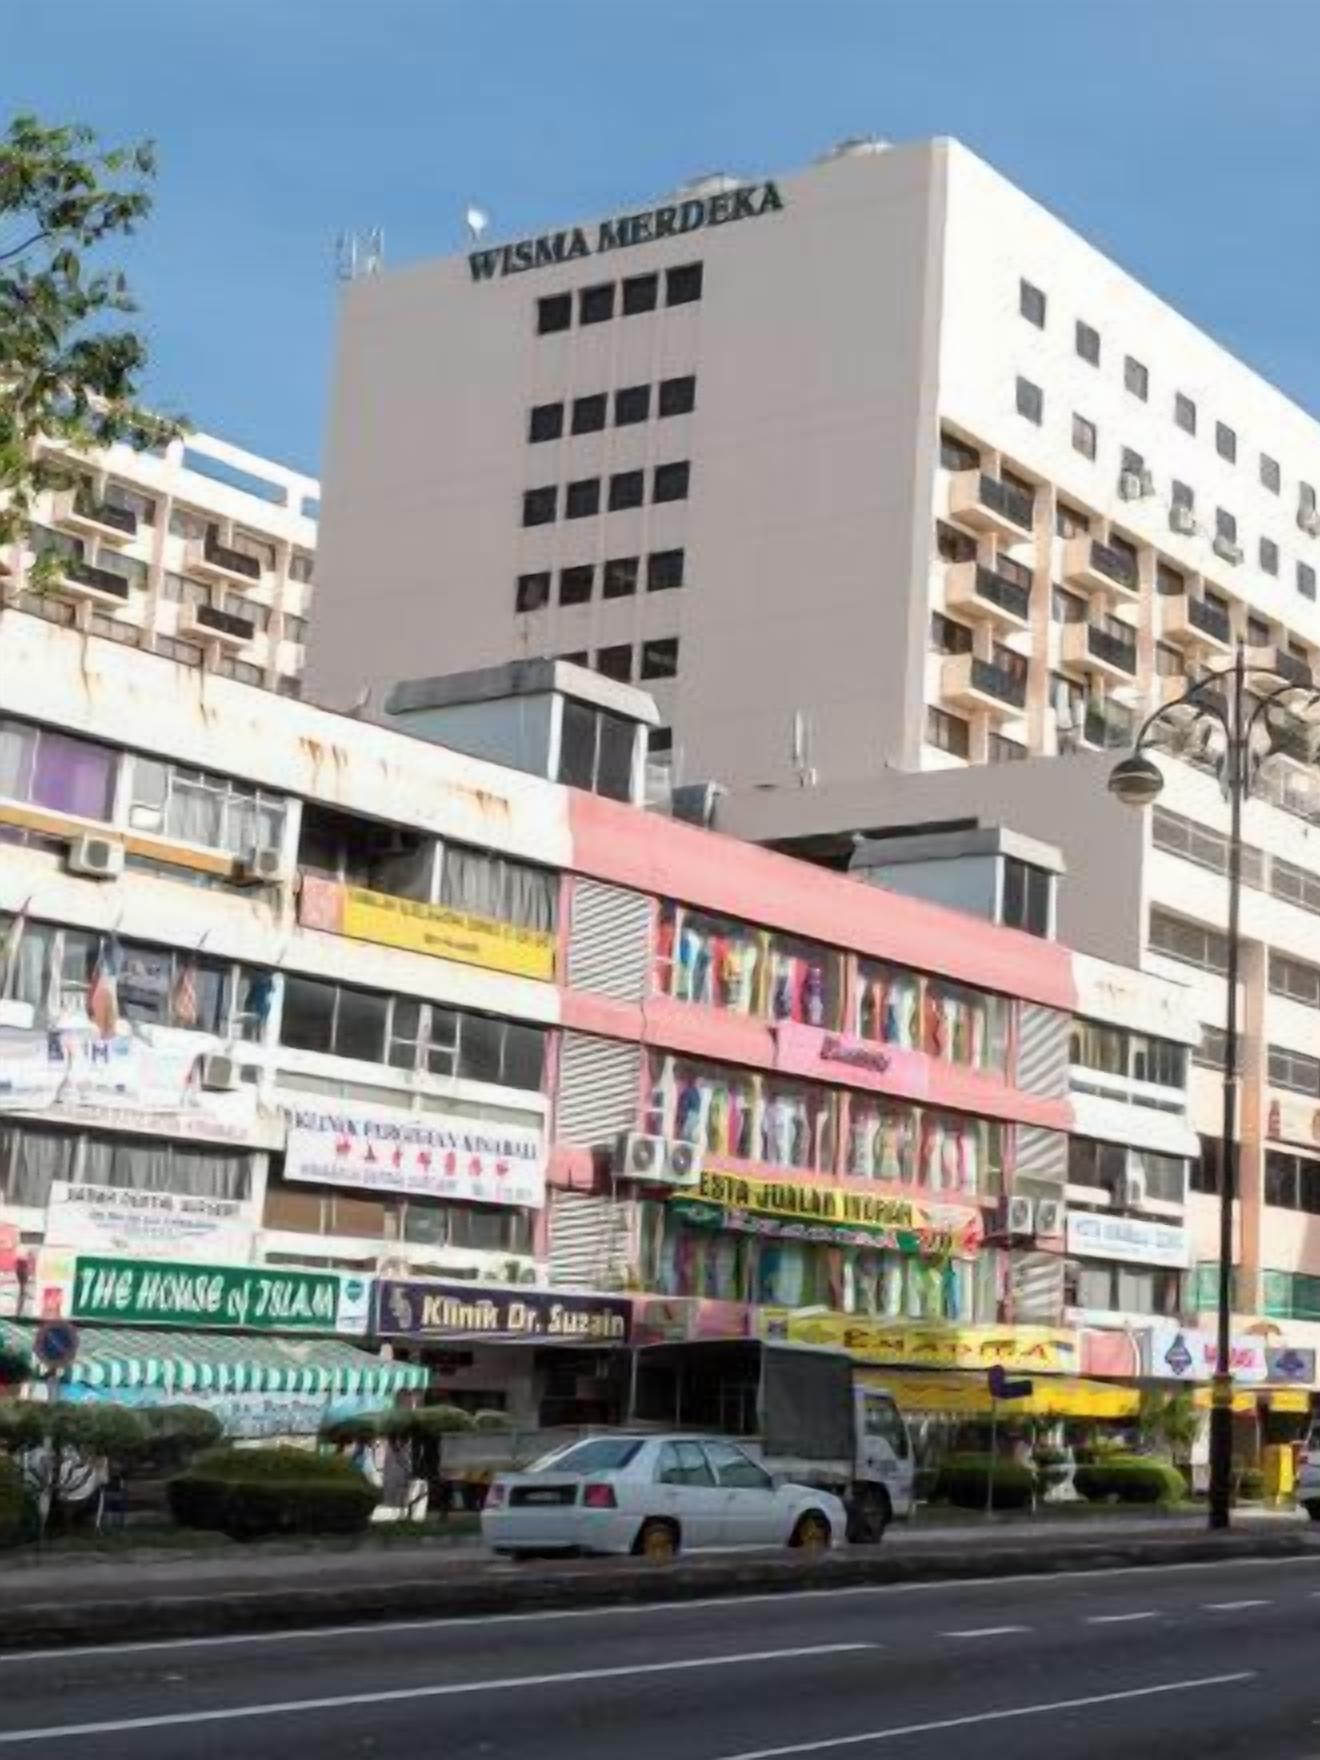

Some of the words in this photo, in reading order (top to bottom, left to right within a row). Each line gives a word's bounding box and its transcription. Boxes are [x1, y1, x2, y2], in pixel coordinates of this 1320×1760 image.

[469, 228, 592, 280] WISMA
[597, 181, 783, 252] MERDEKA
[78, 1267, 133, 1309] THE
[136, 1270, 224, 1313] HOUSE
[227, 1279, 251, 1325] of
[255, 1280, 334, 1318] ISLAM
[422, 1295, 499, 1330] Klinik
[508, 1302, 541, 1333] Dr.
[548, 1303, 626, 1337] Suzain
